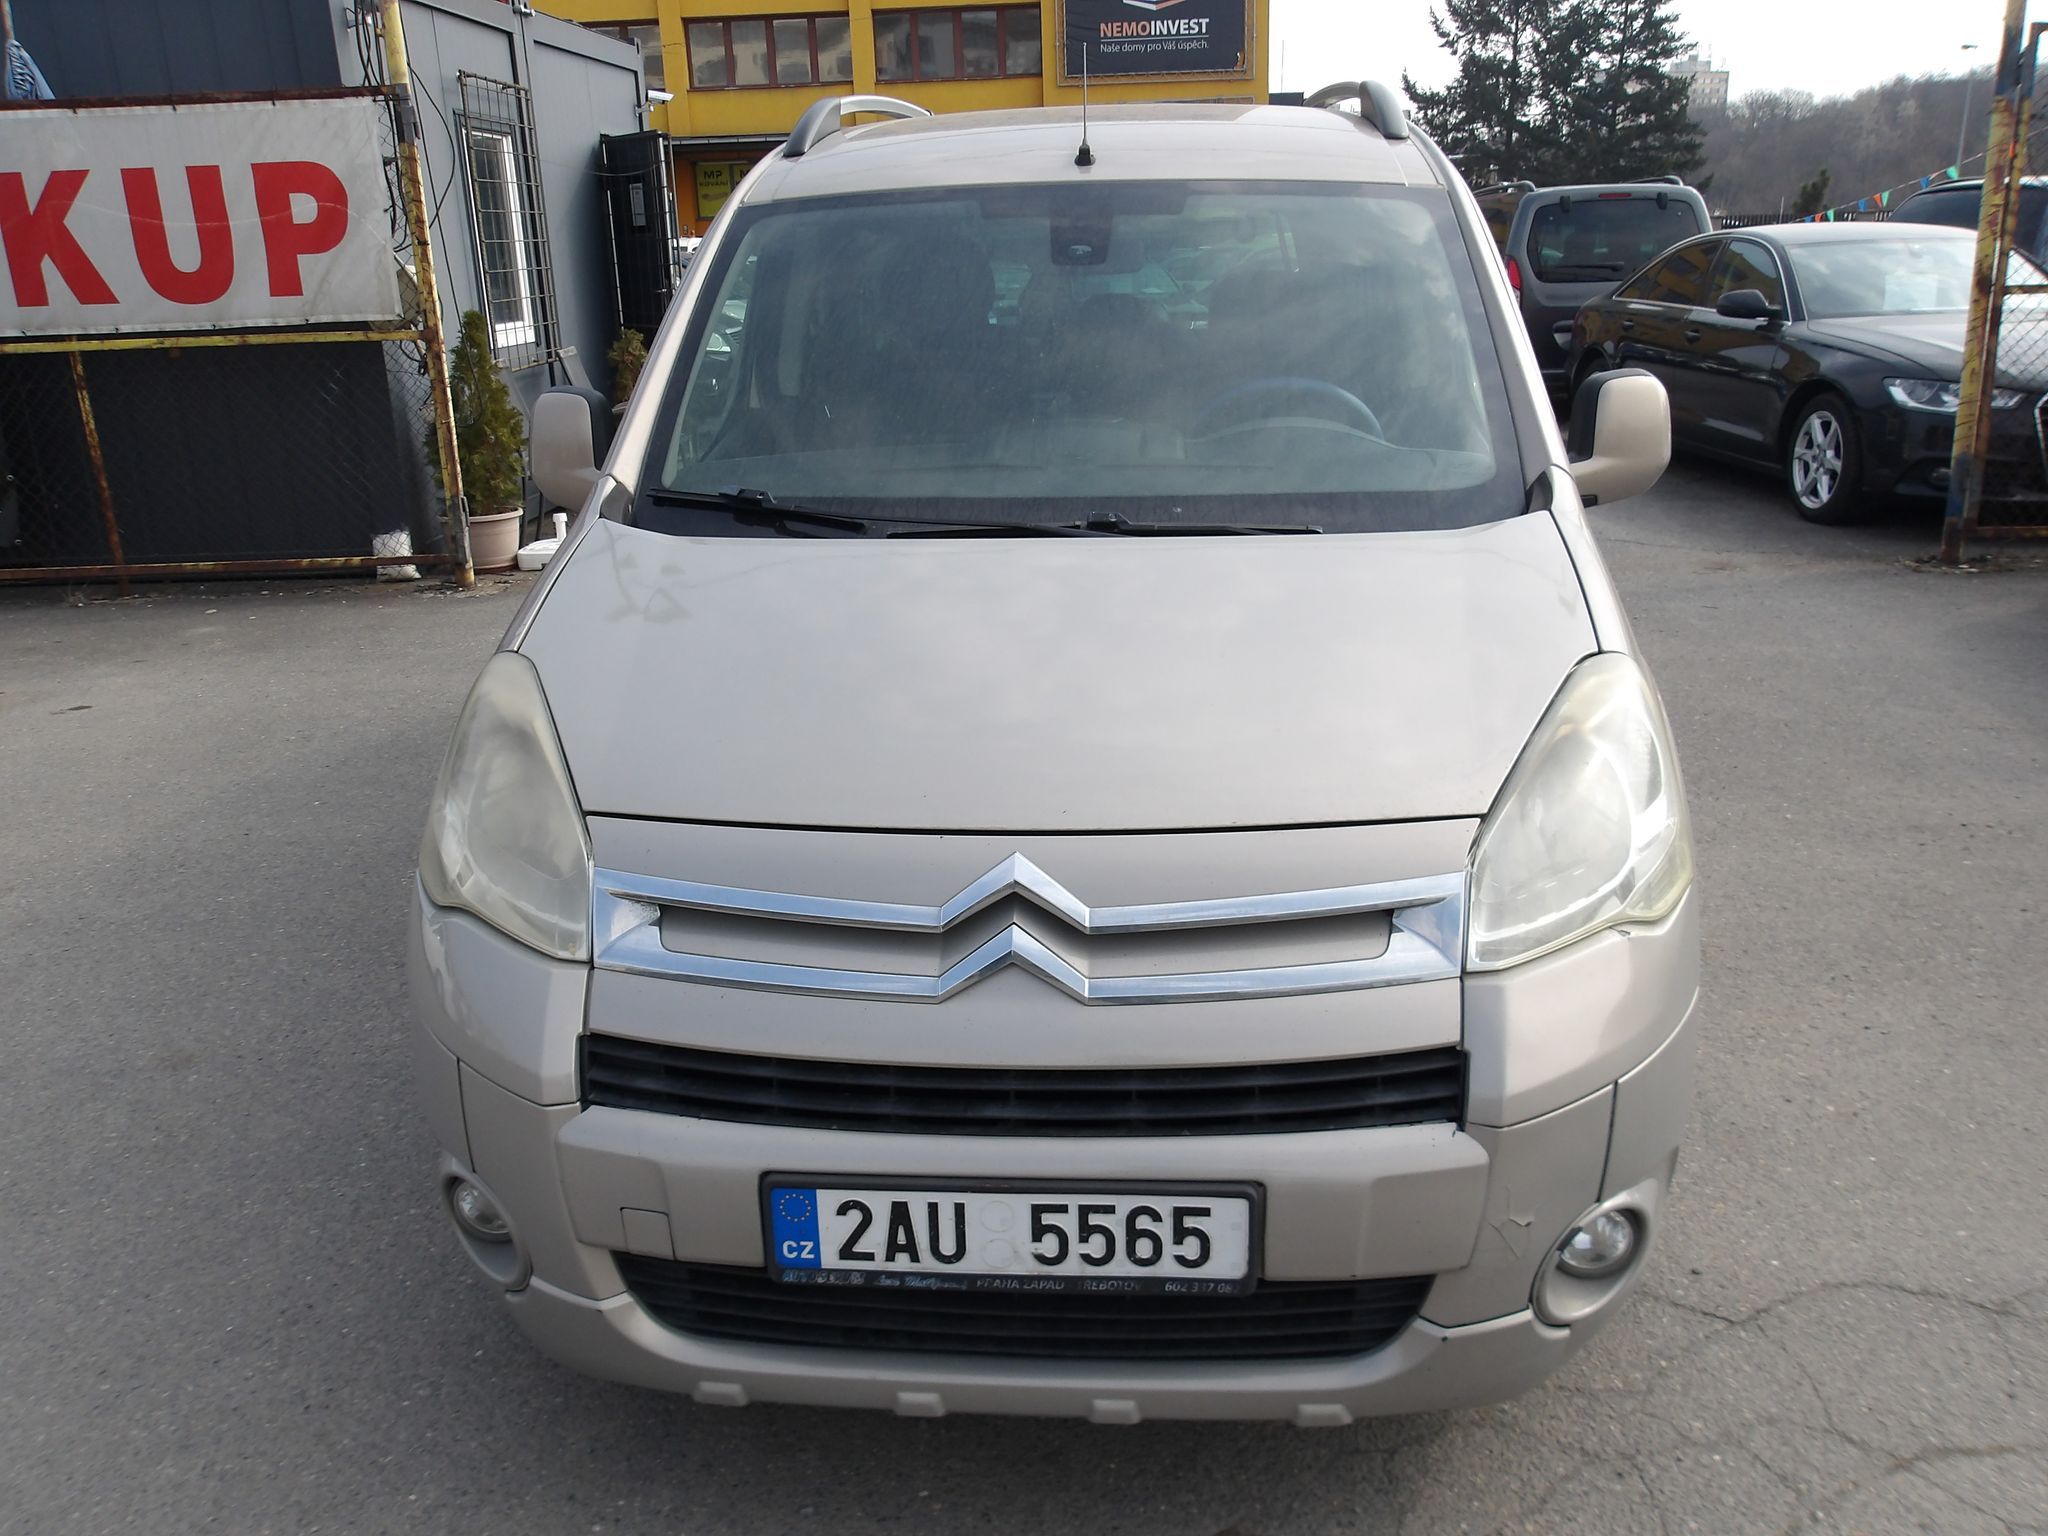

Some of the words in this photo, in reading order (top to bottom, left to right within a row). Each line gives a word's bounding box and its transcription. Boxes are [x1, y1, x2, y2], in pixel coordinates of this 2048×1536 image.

[1100, 18, 1209, 37] NEMOINVEST
[1100, 43, 1120, 53] Naše
[1122, 42, 1145, 53] domy
[1147, 42, 1161, 52] pro
[1162, 40, 1176, 50] Váš
[0, 161, 349, 307] KUP
[835, 1199, 966, 1265] 2AU
[1030, 1203, 1212, 1269] 5565
[782, 1240, 815, 1259] CZ
